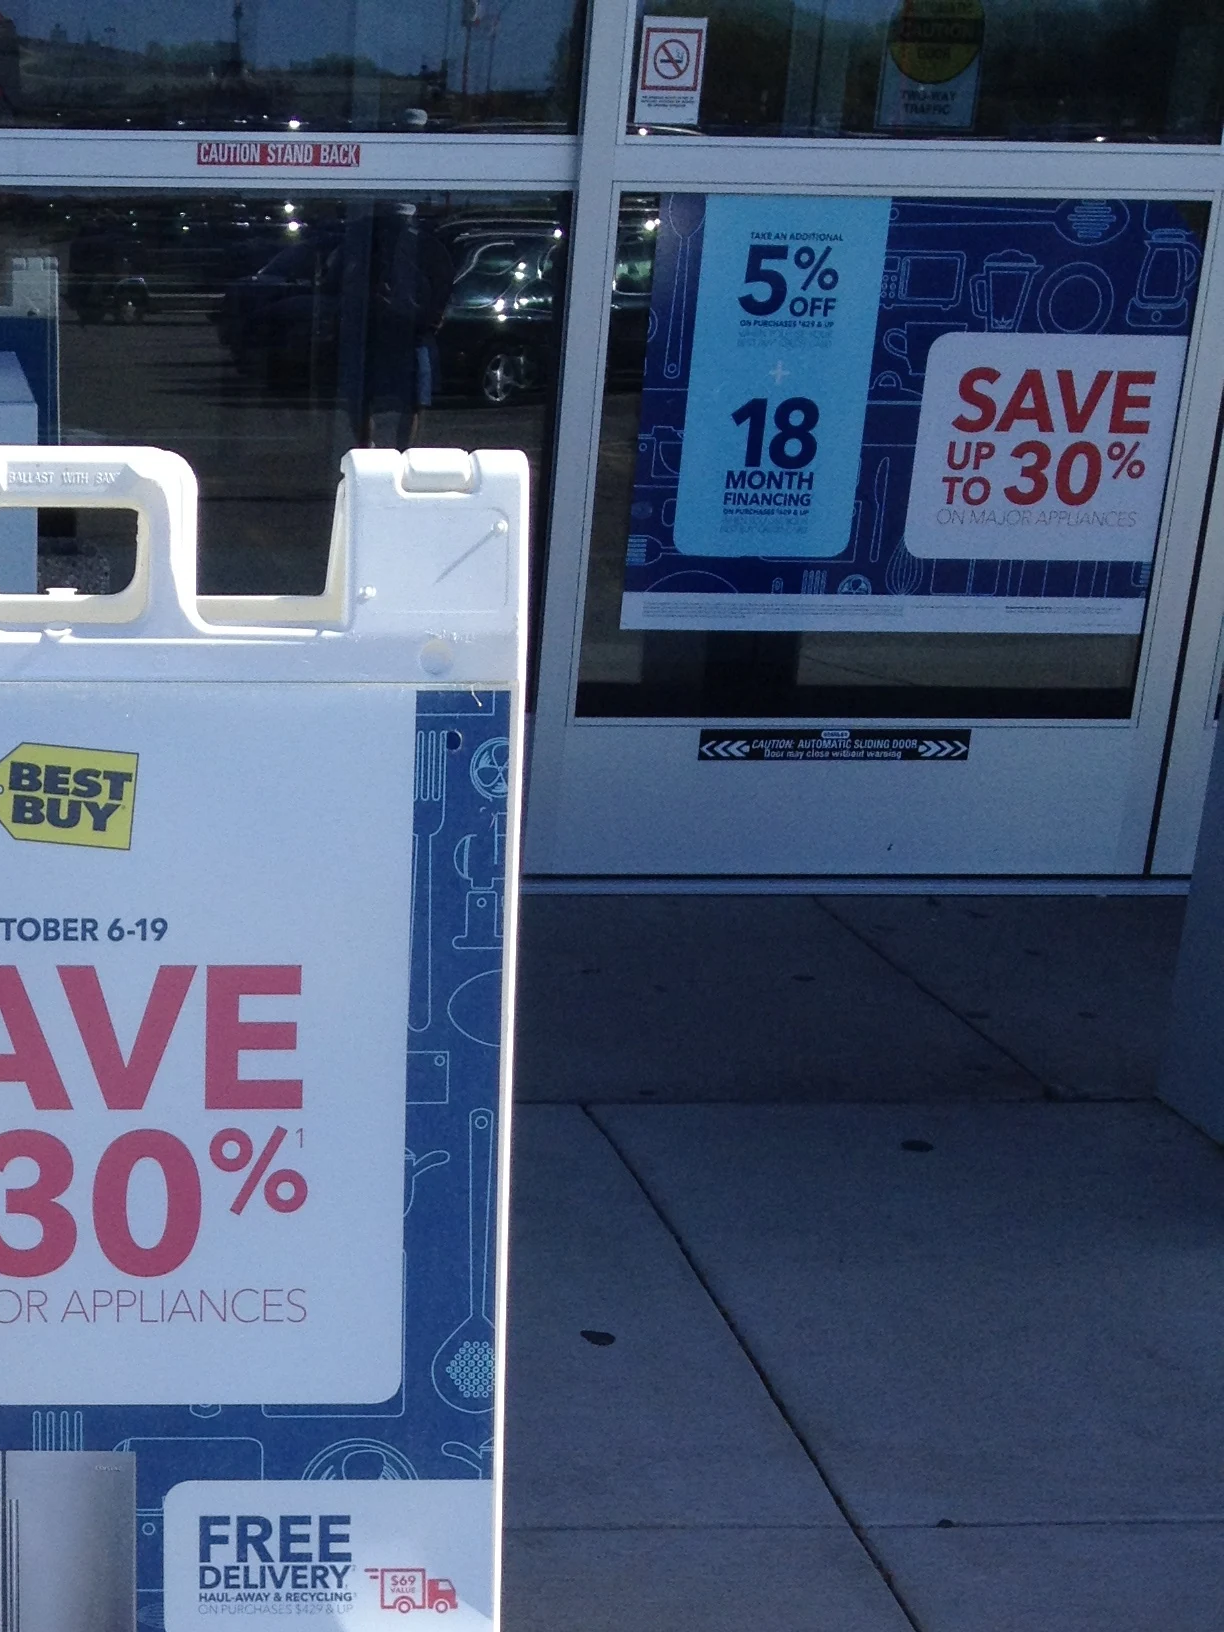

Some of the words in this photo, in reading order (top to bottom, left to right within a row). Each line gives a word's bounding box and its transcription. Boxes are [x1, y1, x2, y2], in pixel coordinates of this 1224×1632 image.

[200, 143, 260, 163] CAUTION
[267, 143, 313, 164] STAND
[320, 144, 358, 165] BACK
[750, 231, 772, 240] TAKE
[774, 232, 787, 241] AN
[789, 232, 844, 242] ADDITIONAL
[737, 244, 840, 317] 5%
[789, 296, 837, 318] OFF
[739, 319, 752, 327] ON
[951, 366, 1157, 435] SAVE
[730, 396, 820, 470] 18
[946, 441, 996, 471] UP
[8, 471, 54, 484] BALLAST
[62, 470, 89, 484] WITH
[95, 470, 122, 484] SAN
[725, 470, 814, 491] MONTH
[942, 476, 992, 507] TO
[1003, 440, 1146, 507] 30%
[723, 492, 812, 507] FINANCING
[936, 508, 965, 525] ON
[970, 509, 1034, 526] MAJOR
[1035, 510, 1139, 528] APPLIANCES
[751, 739, 795, 749] CAUTION:
[797, 739, 852, 749] AUTOMATIC
[853, 739, 890, 749] SLIDING
[891, 739, 918, 749] DOOR
[806, 749, 830, 758] close
[9, 761, 133, 801] BEST
[11, 793, 122, 832] BUY
[107, 917, 169, 942] 6-19
[60, 1288, 308, 1324] APPLIANCES
[198, 1514, 353, 1563] FREE
[390, 1574, 416, 1588] $69
[198, 1592, 271, 1603] HAUL-AWAY
[273, 1592, 283, 1602] &
[285, 1592, 353, 1602] RECYCLING
[198, 1603, 218, 1615] ON
[220, 1603, 293, 1615] PURCHASES
[295, 1603, 323, 1615] $429
[325, 1603, 334, 1614] &
[336, 1603, 354, 1614] UP
